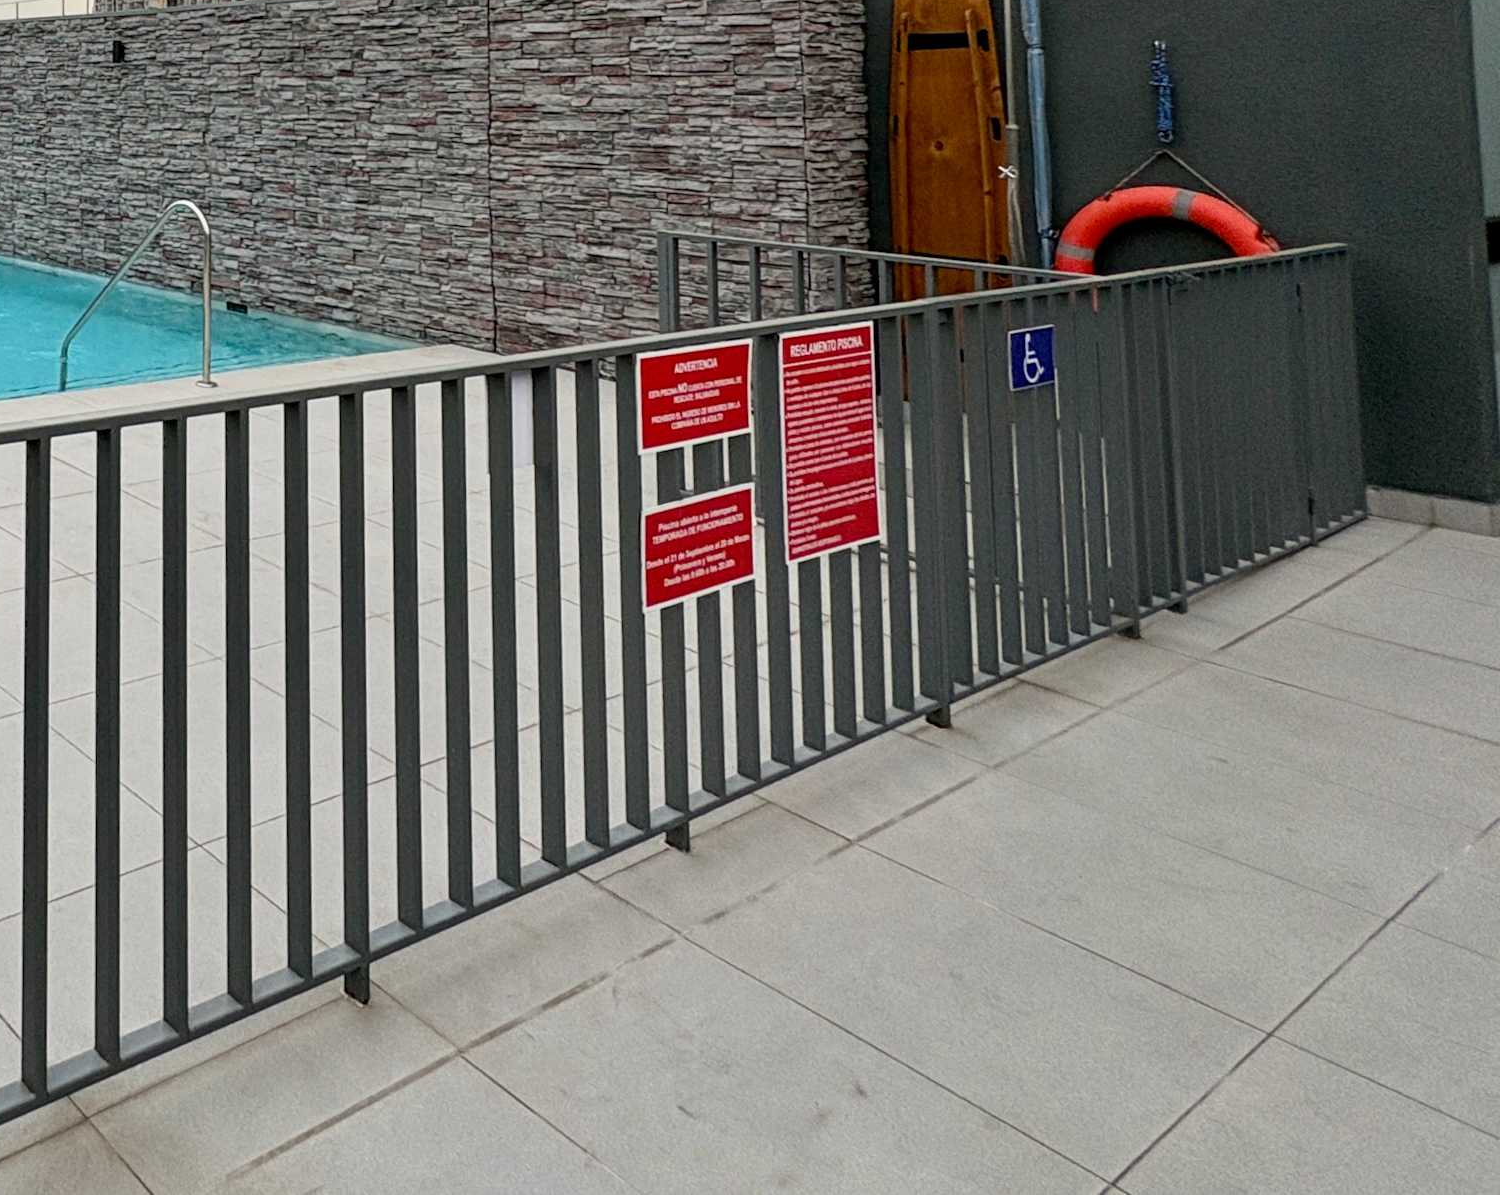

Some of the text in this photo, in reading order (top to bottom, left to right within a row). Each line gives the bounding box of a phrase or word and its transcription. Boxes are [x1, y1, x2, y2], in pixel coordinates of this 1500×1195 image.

[790, 336, 864, 357] REGLAMENTO PISCINA
[675, 358, 718, 374] ADVERTENCIA
[678, 383, 688, 393] NO
[653, 513, 744, 545] TEMPORADA DE FUNCIONAMIENTO
[658, 520, 679, 533] Piscina
[681, 515, 698, 527] abierta
[647, 558, 663, 569] Desde
[671, 554, 677, 563] 21
[678, 552, 685, 561] de
[686, 544, 714, 559] Septiembre
[664, 575, 681, 587] Desde
